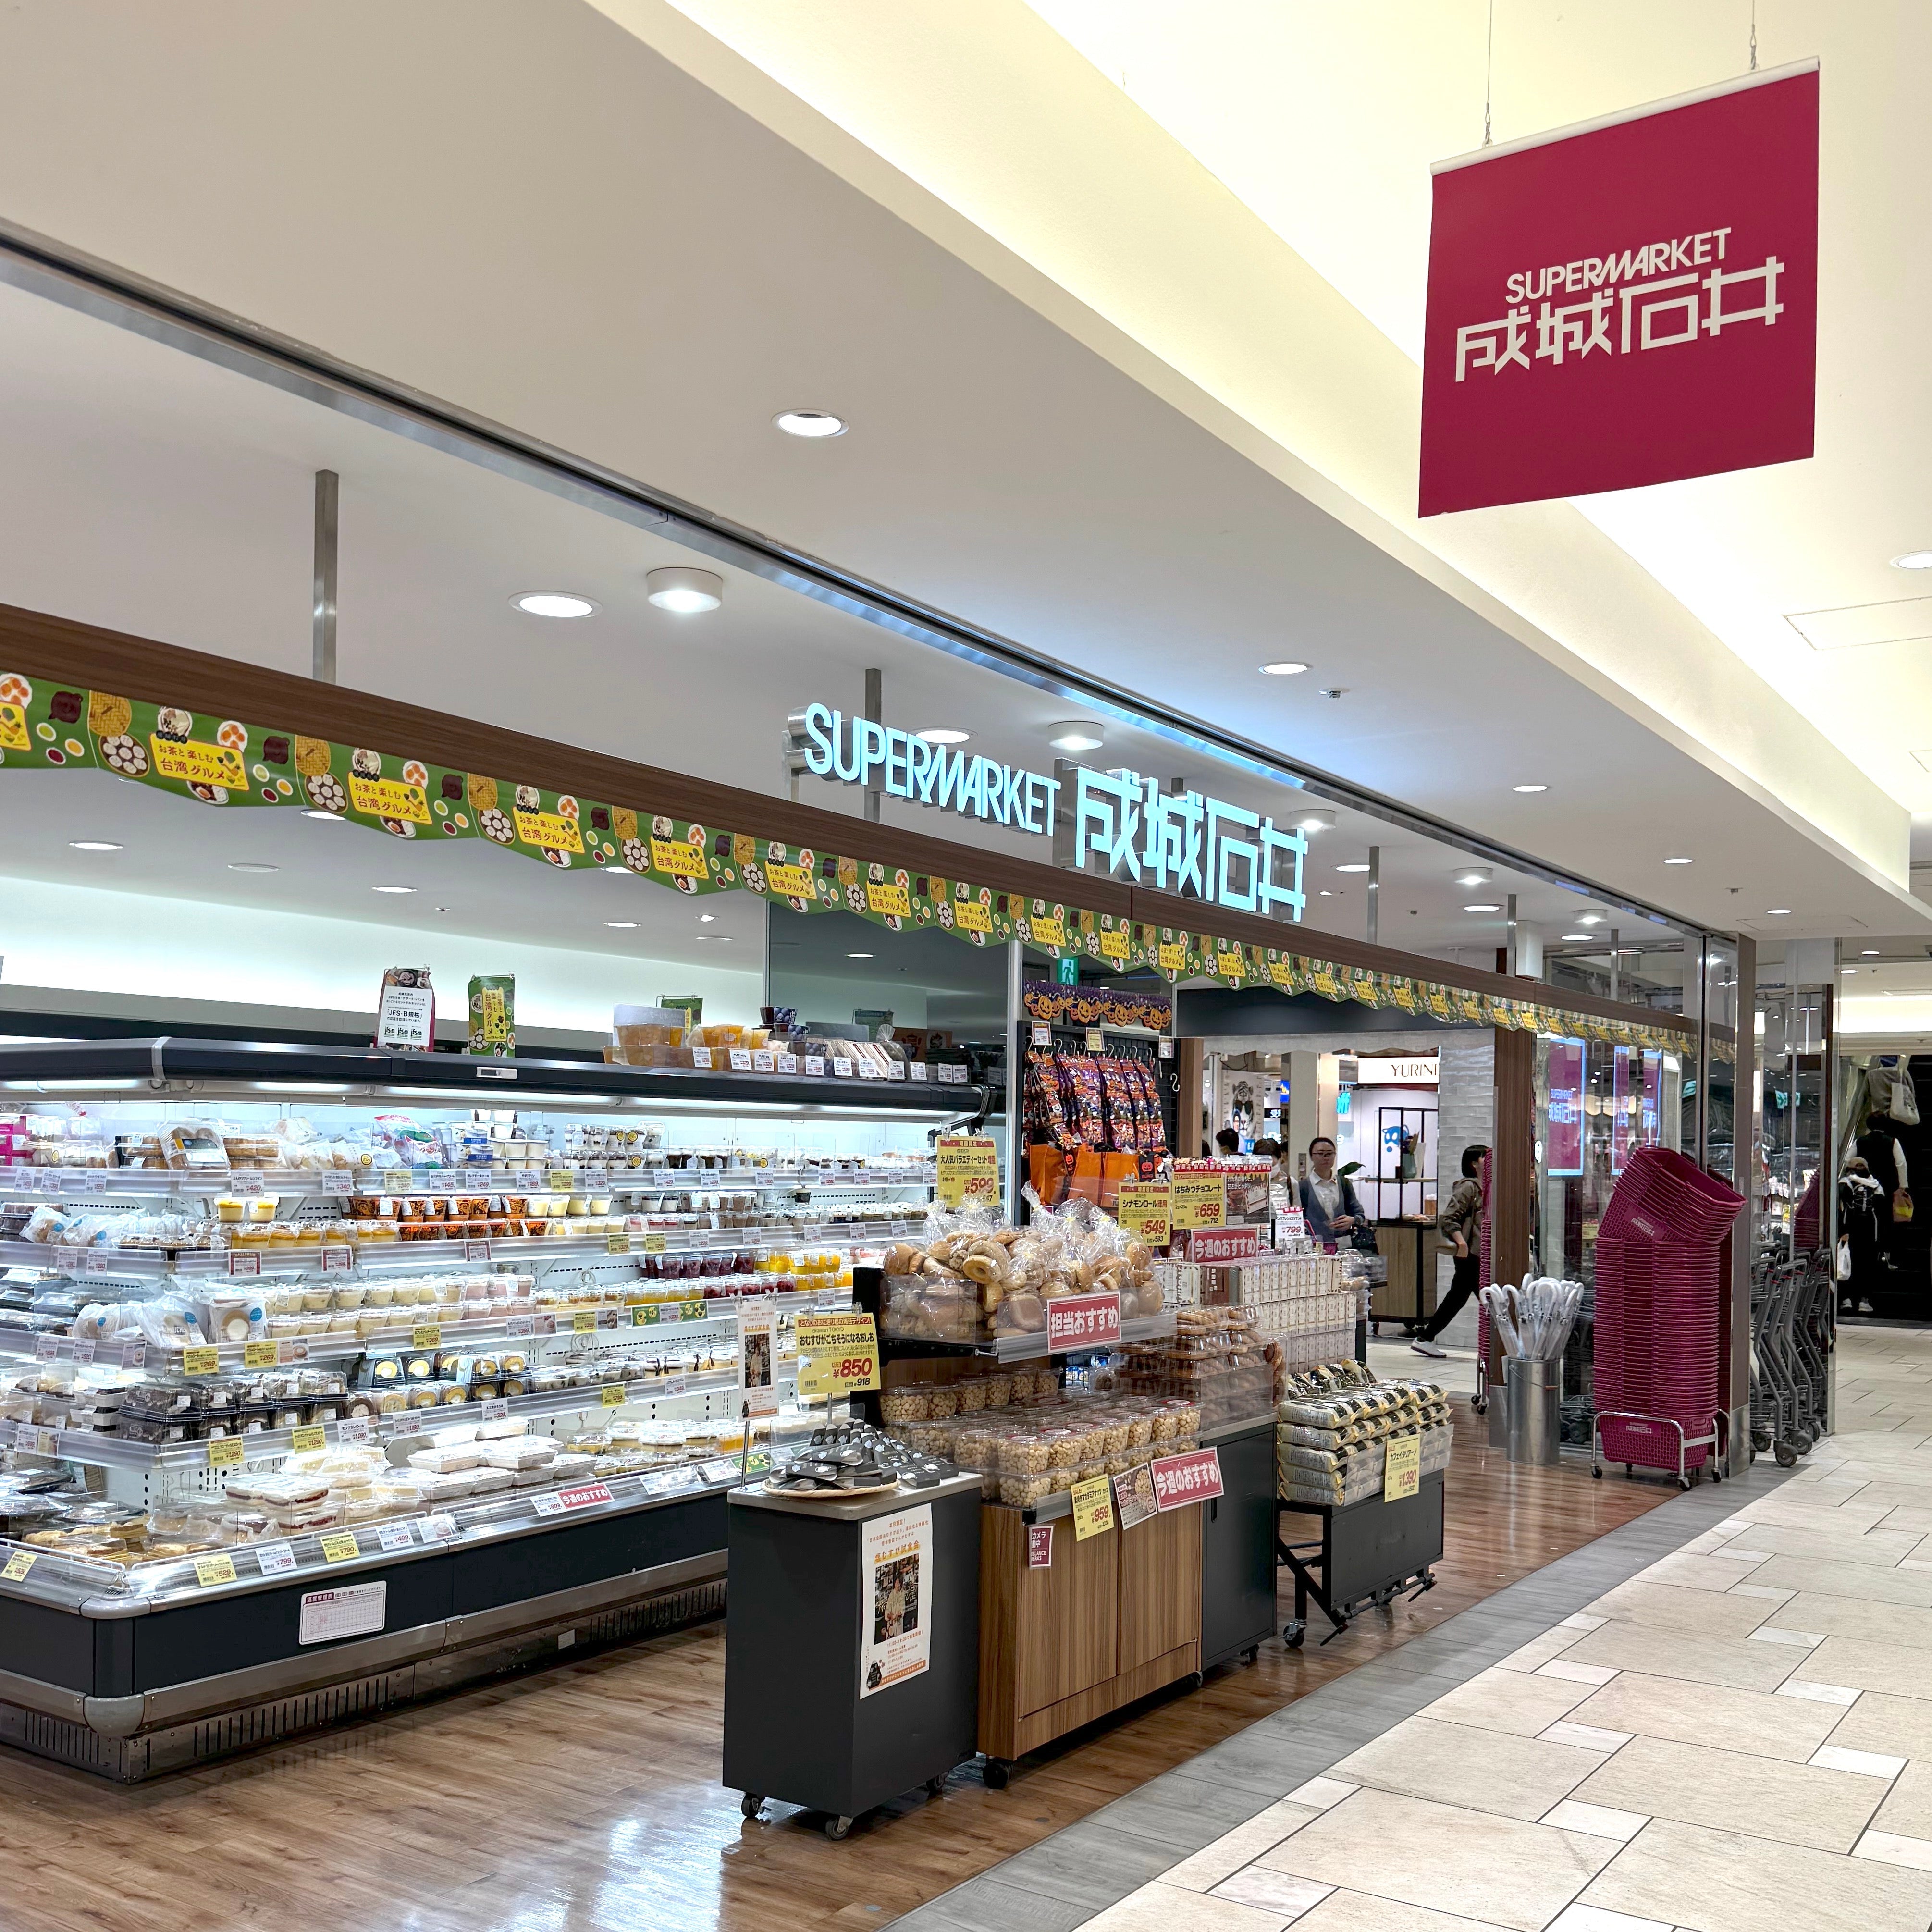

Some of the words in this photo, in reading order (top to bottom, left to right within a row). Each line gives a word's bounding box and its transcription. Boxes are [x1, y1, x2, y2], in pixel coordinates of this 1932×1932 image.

[1505, 227, 1732, 304] SUPERMARKET
[1455, 256, 1784, 382] 成城石井
[159, 744, 213, 763] お茶と楽しむ
[161, 758, 225, 779] 台湾グルメ
[803, 703, 1061, 837] SUPERMARKET
[355, 783, 401, 799] お茶と楽しむ
[357, 796, 411, 814] 台湾グルメ
[520, 817, 558, 830] お茶と楽しむ
[523, 828, 567, 844] 台湾グルメ
[1075, 766, 1308, 923] 成城石井
[657, 856, 694, 871] 台湾グルメ
[772, 879, 804, 891] 台湾グルメ
[872, 898, 900, 910] 台湾グルメ
[1391, 1063, 1439, 1078] YURIN
[1175, 1184, 1221, 1193] はちみつチョコレート
[1195, 1237, 1256, 1259] 今週のおすすめ
[1051, 1304, 1119, 1338] 担当おすすめ
[833, 1358, 873, 1378] ¥850
[1156, 1462, 1219, 1497] 今週のおすすめ
[562, 1488, 609, 1505] 今週のおすすめ
[1032, 1531, 1046, 1539] カメラ
[219, 1569, 231, 1577] 529
